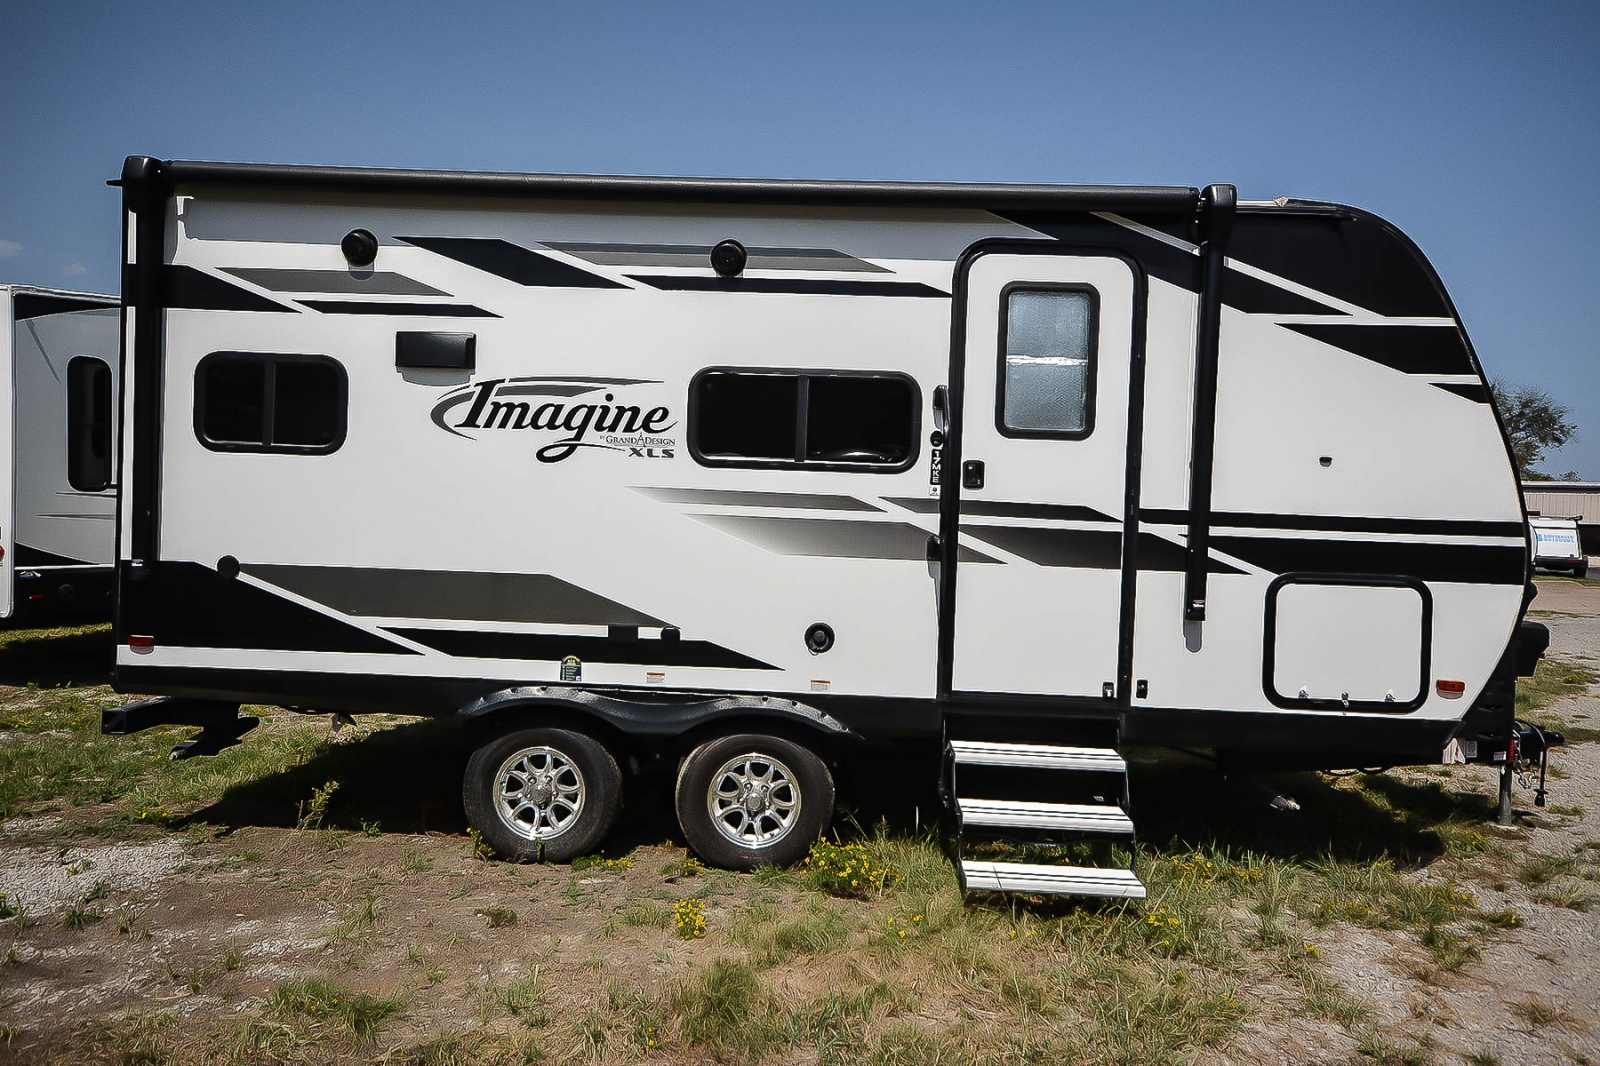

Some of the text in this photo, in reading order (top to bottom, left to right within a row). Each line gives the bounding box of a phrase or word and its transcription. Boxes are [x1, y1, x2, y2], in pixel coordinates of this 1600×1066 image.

[454, 378, 678, 463] Imagine
[605, 435, 637, 445] GRAND
[645, 437, 676, 446] DESIGN
[628, 447, 675, 459] XLS
[931, 451, 941, 484] 17MKE
